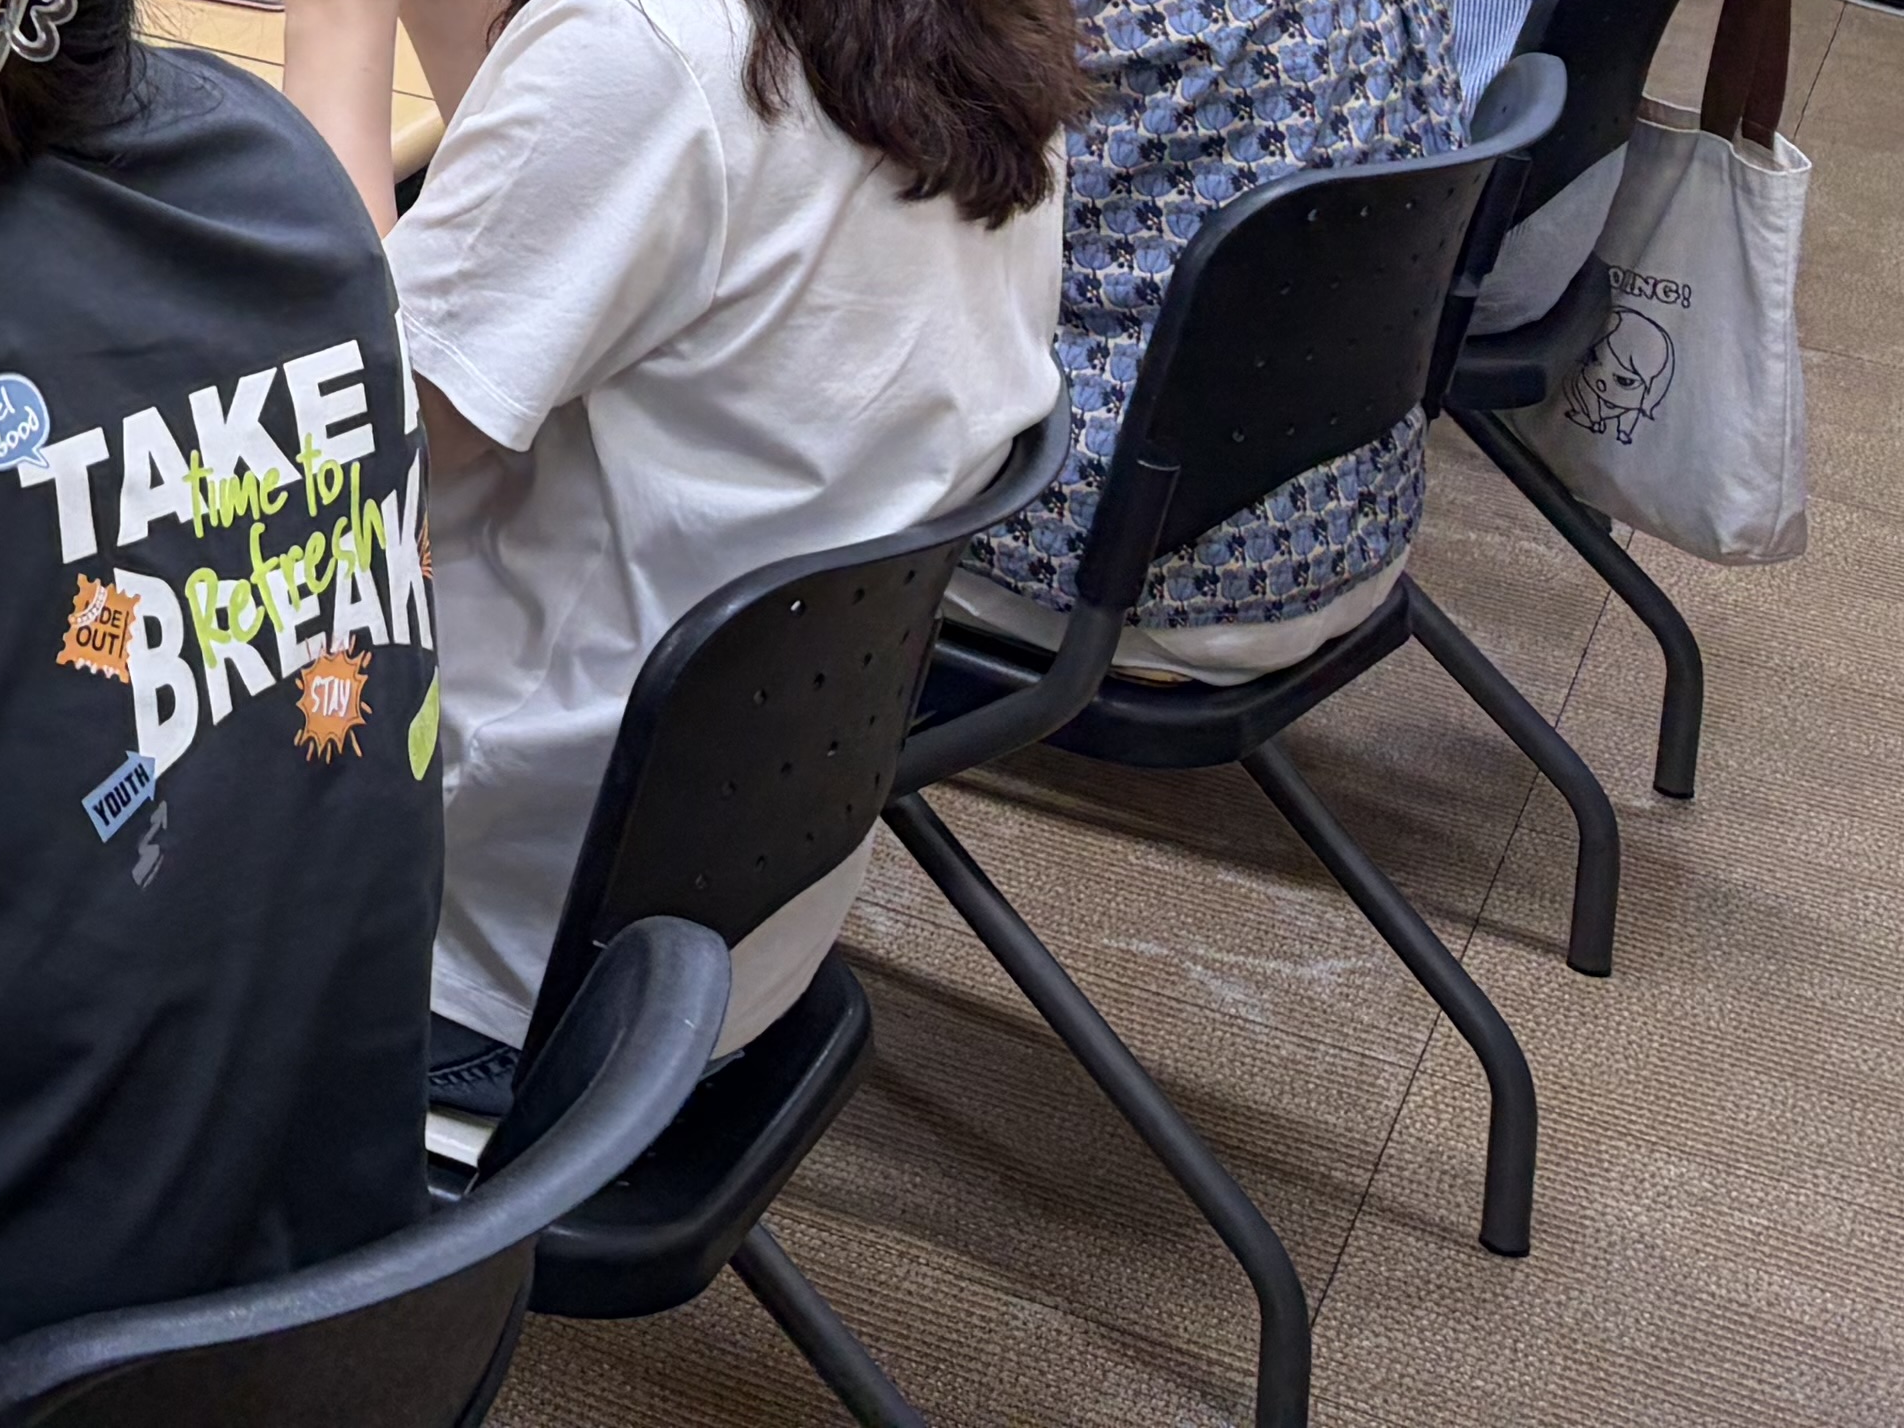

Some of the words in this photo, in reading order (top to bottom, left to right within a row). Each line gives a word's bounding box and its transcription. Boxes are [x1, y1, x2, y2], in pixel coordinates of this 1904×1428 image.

[17, 339, 376, 564] TAKE
[182, 448, 289, 539] time
[295, 432, 345, 518] to
[113, 448, 434, 779] BREAK
[184, 460, 388, 670] Refresh
[75, 624, 121, 658] OUT
[310, 674, 352, 718] STAY
[91, 762, 152, 828] YOUTH
